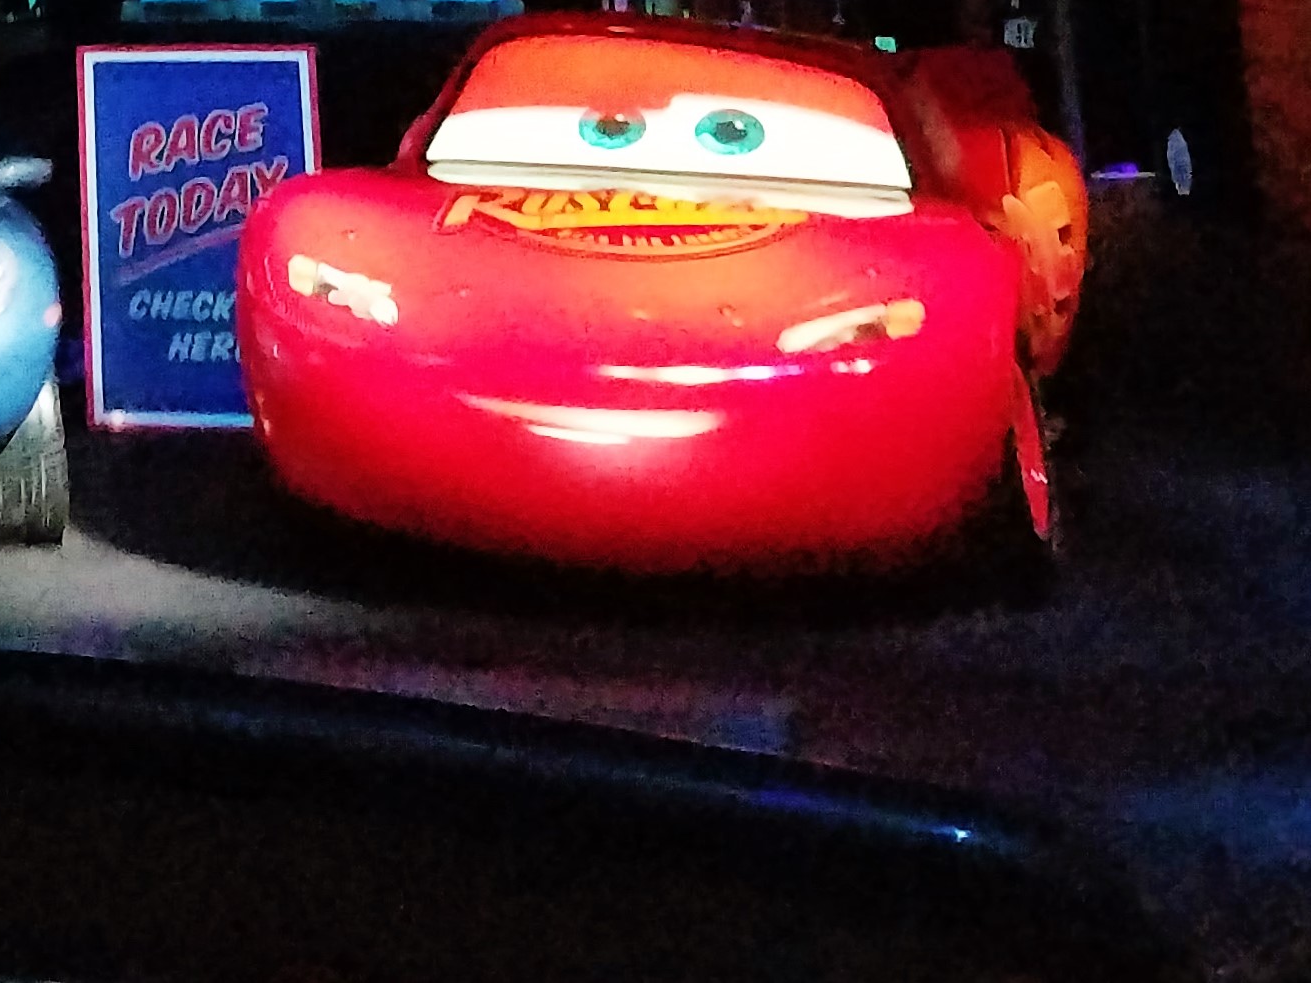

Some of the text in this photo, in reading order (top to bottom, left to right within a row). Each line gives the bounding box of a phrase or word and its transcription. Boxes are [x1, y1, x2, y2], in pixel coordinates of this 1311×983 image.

[129, 102, 269, 181] RACE
[110, 155, 289, 258] TODAY
[129, 289, 237, 322] CHECK
[168, 330, 241, 363] HER
